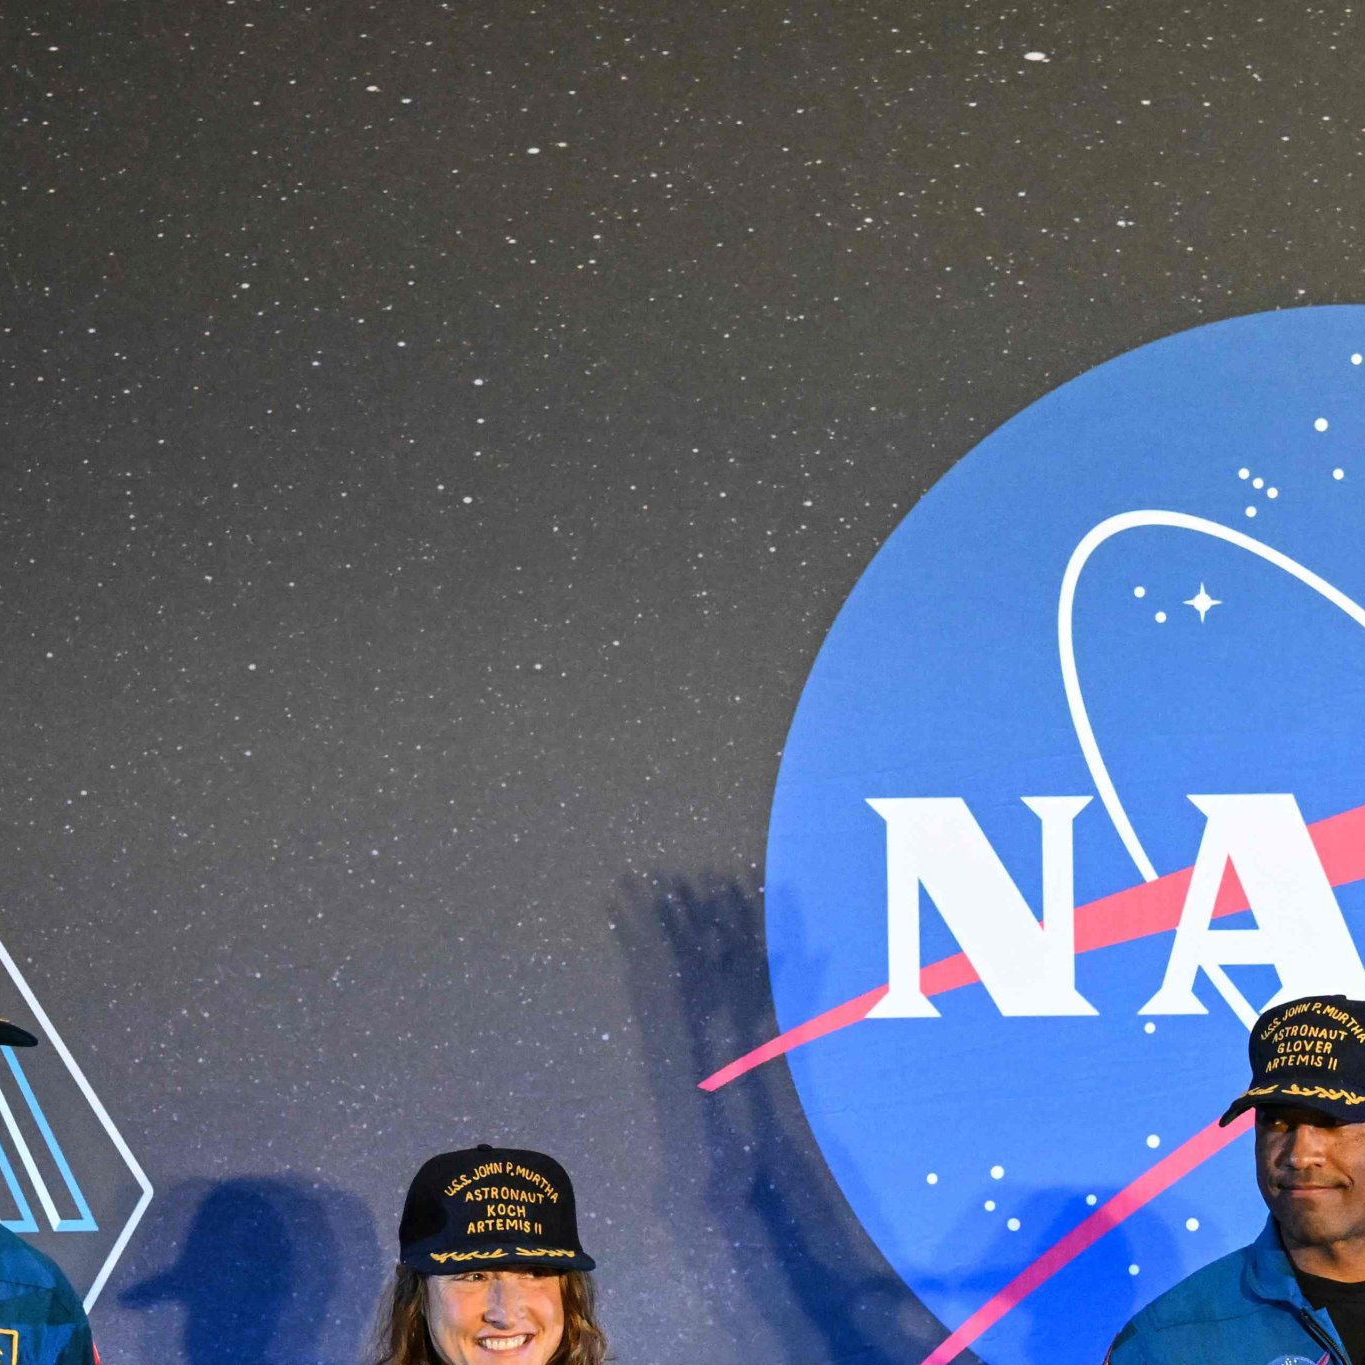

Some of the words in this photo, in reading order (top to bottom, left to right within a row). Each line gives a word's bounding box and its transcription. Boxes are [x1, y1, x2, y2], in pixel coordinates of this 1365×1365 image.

[1282, 1003, 1311, 1021] JOHN
[1311, 1002, 1322, 1014] P.
[1272, 1024, 1348, 1044] ASTRONAUT
[1277, 1040, 1333, 1054] GLOVER
[1265, 1054, 1323, 1073] ARTEMIS
[472, 1162, 502, 1180] JOHN
[505, 1161, 515, 1177] P.
[515, 1164, 559, 1203] MURTHA
[465, 1187, 545, 1204] ASTRONAUT
[486, 1203, 526, 1218] KOCH
[467, 1218, 531, 1234] ARTEMIS
[534, 1222, 542, 1235] II
